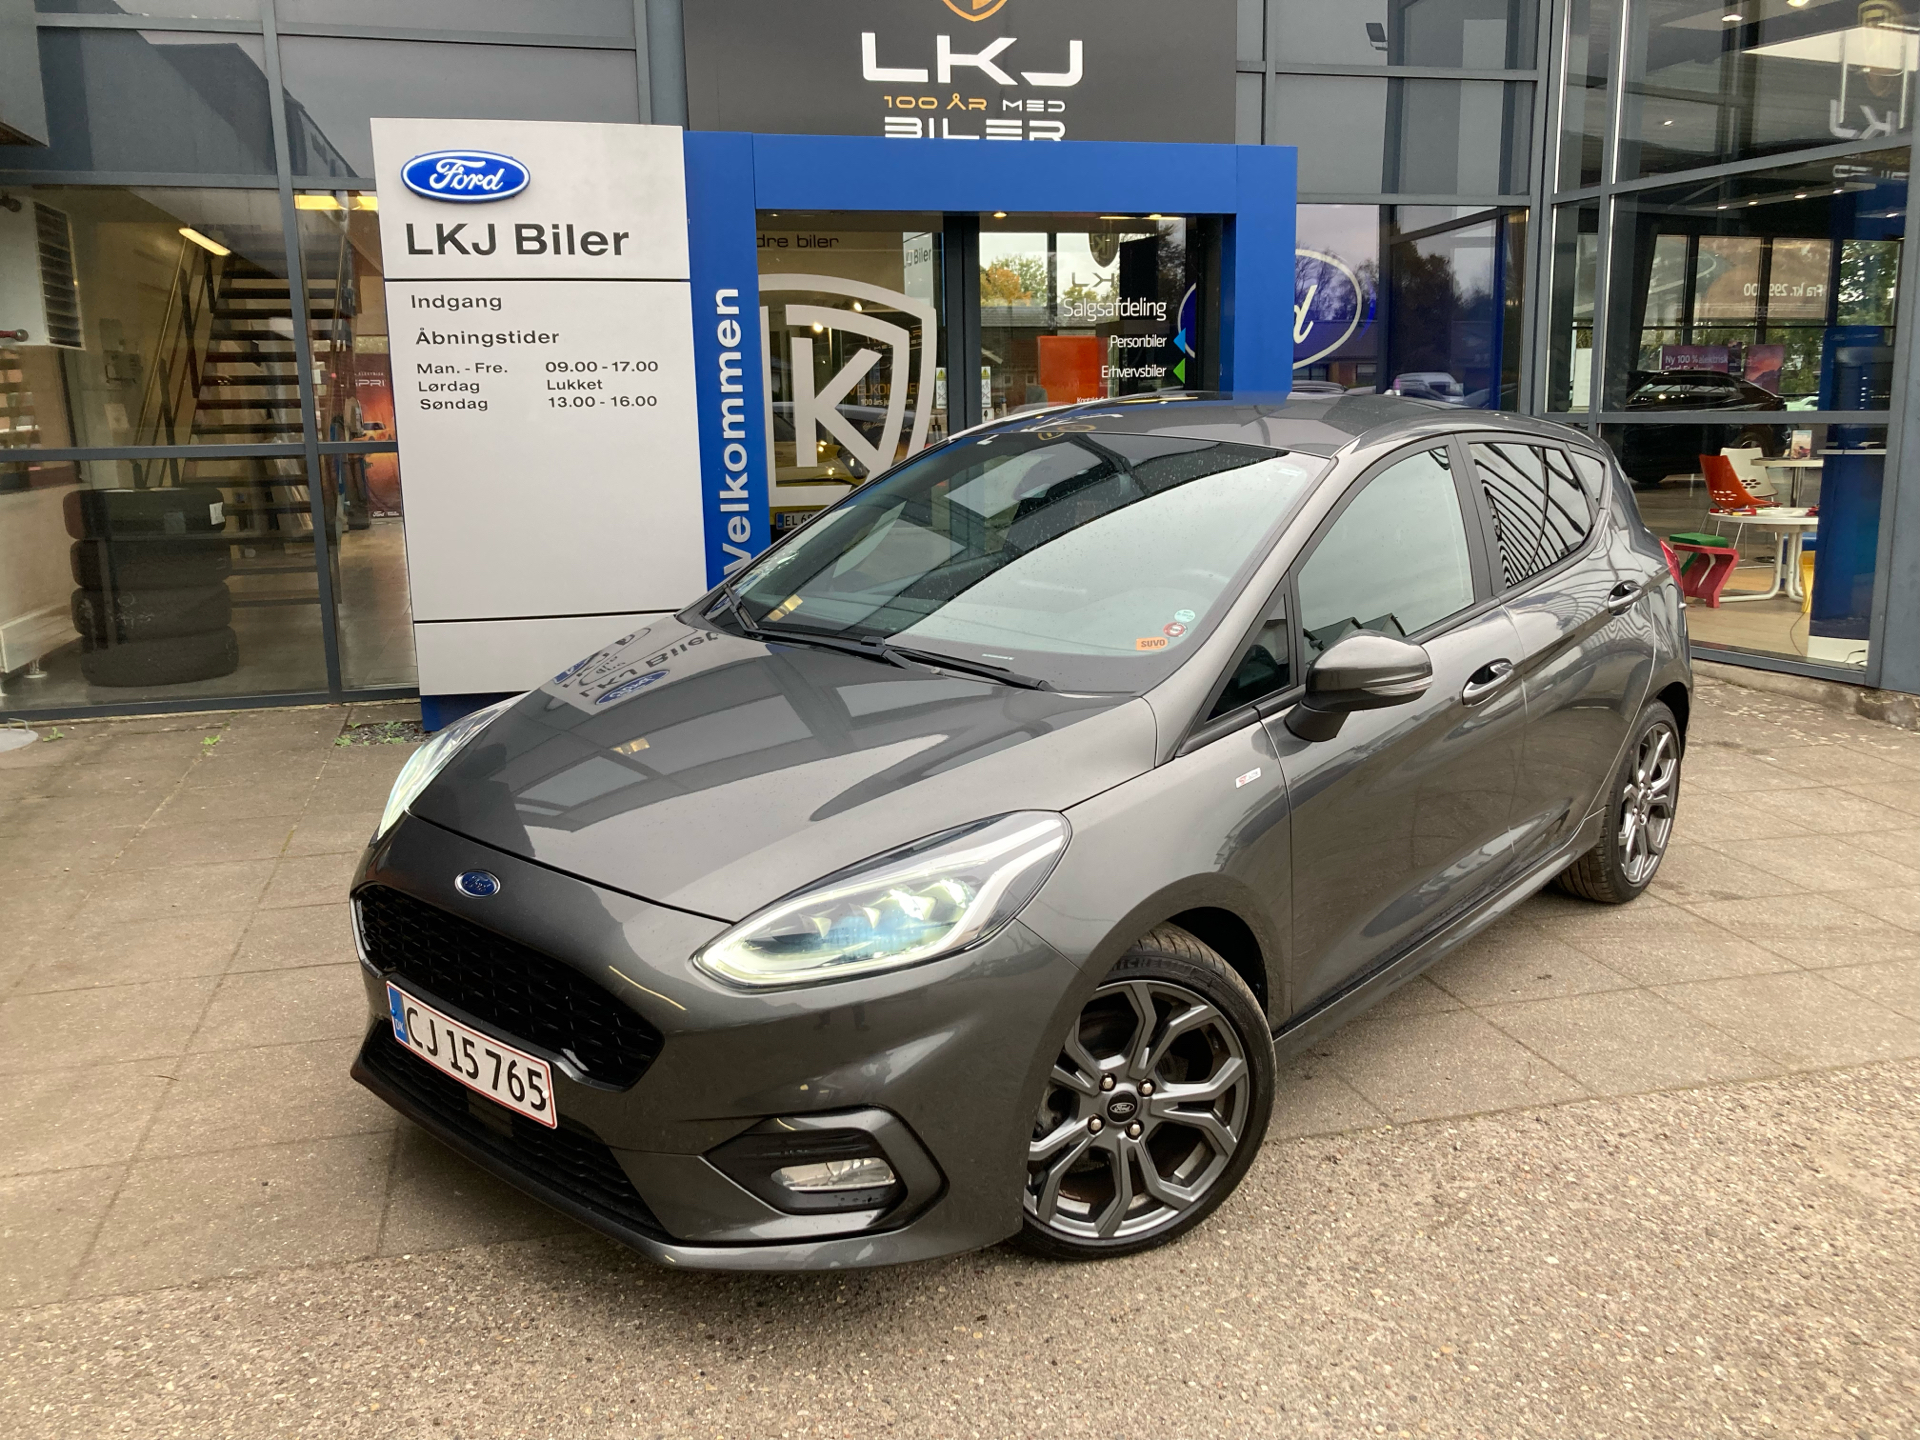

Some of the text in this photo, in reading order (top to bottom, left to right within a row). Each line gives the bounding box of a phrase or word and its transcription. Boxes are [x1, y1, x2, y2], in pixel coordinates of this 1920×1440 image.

[861, 31, 1084, 87] LKJ
[883, 92, 1066, 113] 100 ÅR MED
[884, 116, 1066, 142] BILER
[429, 158, 505, 191] Ford
[406, 222, 630, 257] LKJ Biler
[756, 234, 840, 248] dre biler
[410, 293, 503, 312] Indgang
[1063, 297, 1167, 322] Salgsafdeling
[415, 327, 560, 348] Åbningstider
[1110, 334, 1167, 348] Personbiler
[416, 362, 460, 375] Man.
[475, 362, 508, 374] Fre.
[1101, 365, 1167, 378] Erhvervsbiler
[418, 380, 481, 394] Lørdag
[546, 378, 603, 391] Lukket
[419, 398, 489, 412] Søndag
[548, 395, 596, 408] 13.00
[610, 395, 658, 407] 16.00
[715, 287, 753, 577] Velkommen
[785, 515, 798, 527] EL
[1140, 639, 1166, 648] SUVO
[406, 1006, 547, 1112] CJ 15 765
